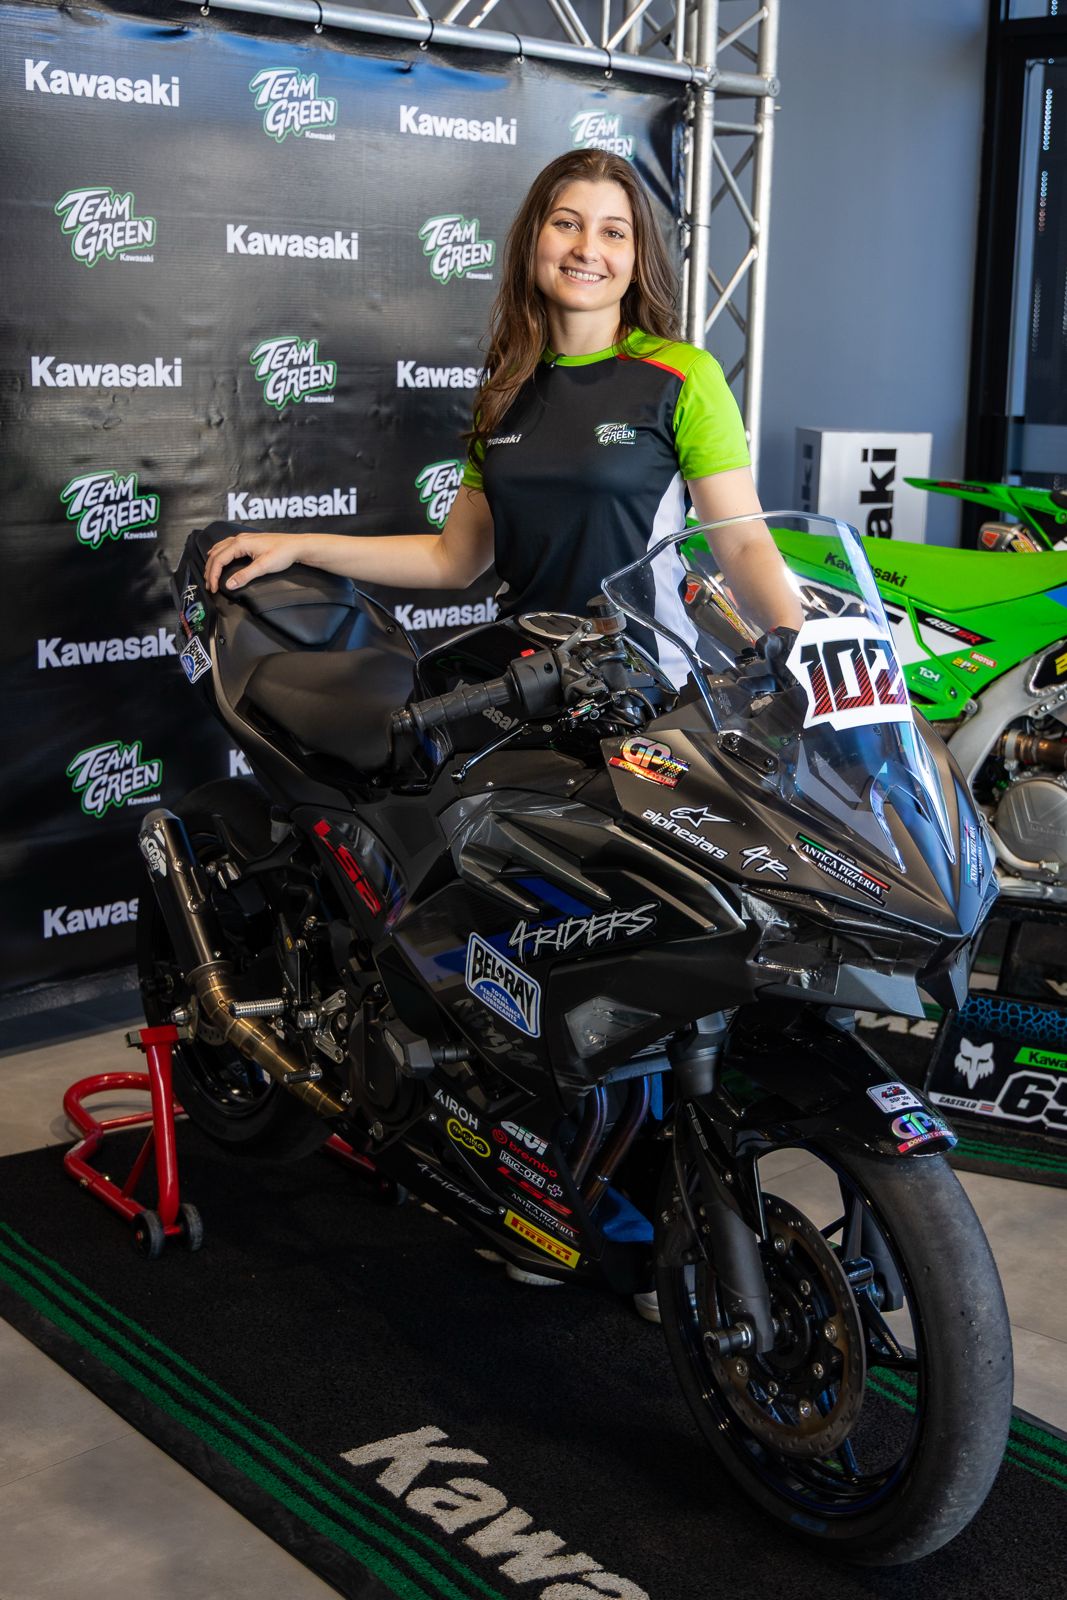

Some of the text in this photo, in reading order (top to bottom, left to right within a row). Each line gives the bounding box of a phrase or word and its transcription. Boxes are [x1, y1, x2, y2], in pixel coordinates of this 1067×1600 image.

[25, 59, 180, 107] Kawasaki
[251, 69, 315, 105] TEAM
[266, 99, 335, 137] GREEN
[304, 130, 336, 141] Kawasaki
[400, 105, 517, 145] Kawasaki
[571, 112, 620, 142] TEAM
[58, 190, 131, 229] TEAM
[74, 220, 152, 263] GREEN
[226, 224, 359, 260] Kawasaki
[420, 217, 477, 251] TEAM
[119, 253, 154, 263] Kawasaki
[433, 243, 493, 278] GREEN
[31, 356, 182, 387] Kawasaki
[252, 339, 315, 376] TEAM
[266, 364, 334, 404] GREEN
[304, 395, 335, 403] Kawasaki
[596, 423, 627, 435] TEAM
[600, 431, 635, 444] GREEN
[63, 473, 135, 514] TEAM
[227, 488, 357, 520] Kawasaki
[79, 497, 157, 545] GREEN
[123, 531, 158, 540] Kawasaki
[394, 598, 500, 631] Kawasak
[37, 628, 178, 669] Kawasak
[972, 653, 997, 667] MOTUL
[800, 639, 907, 718] 102
[70, 743, 138, 786] TEAM
[85, 762, 159, 813] GREEN
[127, 795, 161, 806] Kawasaki
[642, 809, 729, 860] alpinestars
[740, 845, 788, 880] 4R
[802, 844, 881, 895] ANTICA PIZZERIA
[817, 862, 856, 888] NAPOLETANA
[480, 985, 521, 1019] PERFORMANCE
[482, 994, 518, 1023] LUBRICANTS
[491, 987, 510, 1005] TOTAL
[434, 1089, 478, 1130] AIROH
[938, 1095, 977, 1109] CASTILLO
[501, 1152, 545, 1187] Muc-Off
[509, 1141, 558, 1178] brembo
[511, 1216, 573, 1261] PIRELLI
